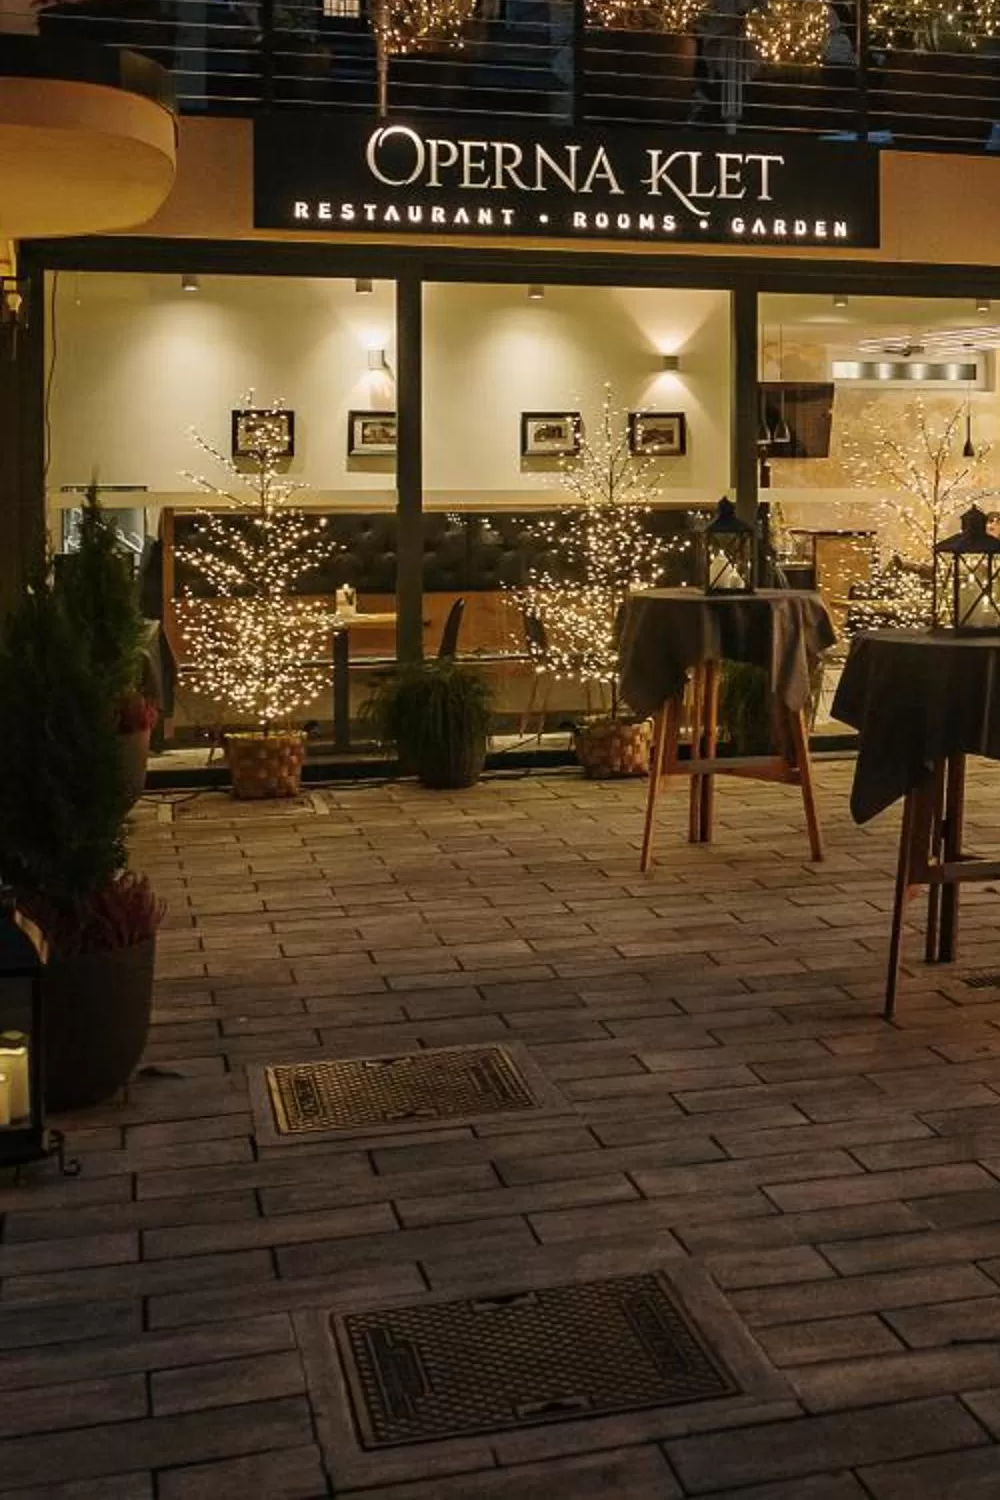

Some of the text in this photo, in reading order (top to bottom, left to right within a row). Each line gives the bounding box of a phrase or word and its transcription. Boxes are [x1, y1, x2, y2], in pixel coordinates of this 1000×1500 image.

[366, 125, 785, 216] OPERNA KLET
[294, 202, 847, 237] RESTAURANT ROOMS GARDEN
